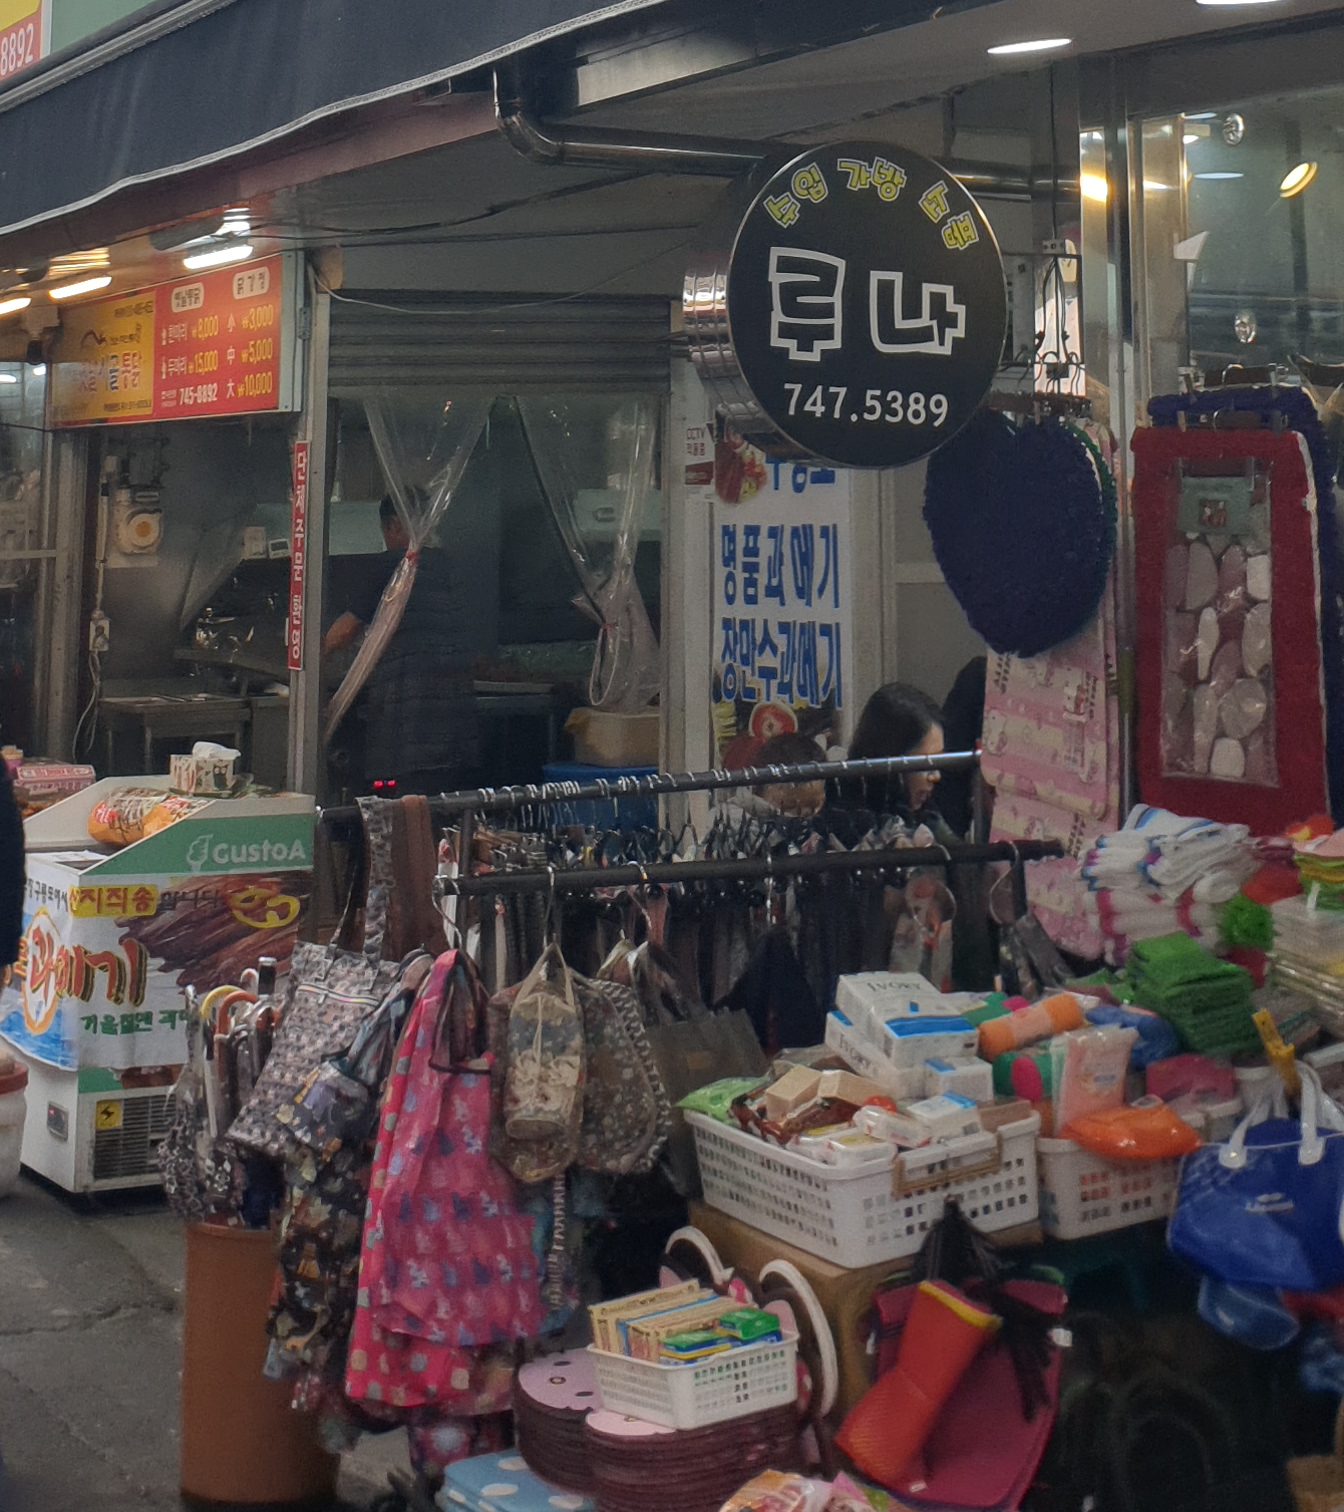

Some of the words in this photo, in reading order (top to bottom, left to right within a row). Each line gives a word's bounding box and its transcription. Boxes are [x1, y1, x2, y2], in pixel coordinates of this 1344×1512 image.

[763, 161, 828, 228] 수입
[836, 156, 908, 202] 가방
[918, 180, 979, 251] 소품
[768, 246, 966, 362] 루나
[226, 345, 236, 366] 中
[178, 382, 219, 406] 745-8892
[783, 382, 949, 428] 747.5389
[686, 427, 706, 440] CCTV
[69, 887, 154, 914] 산지직송
[159, 888, 219, 912] 합니다
